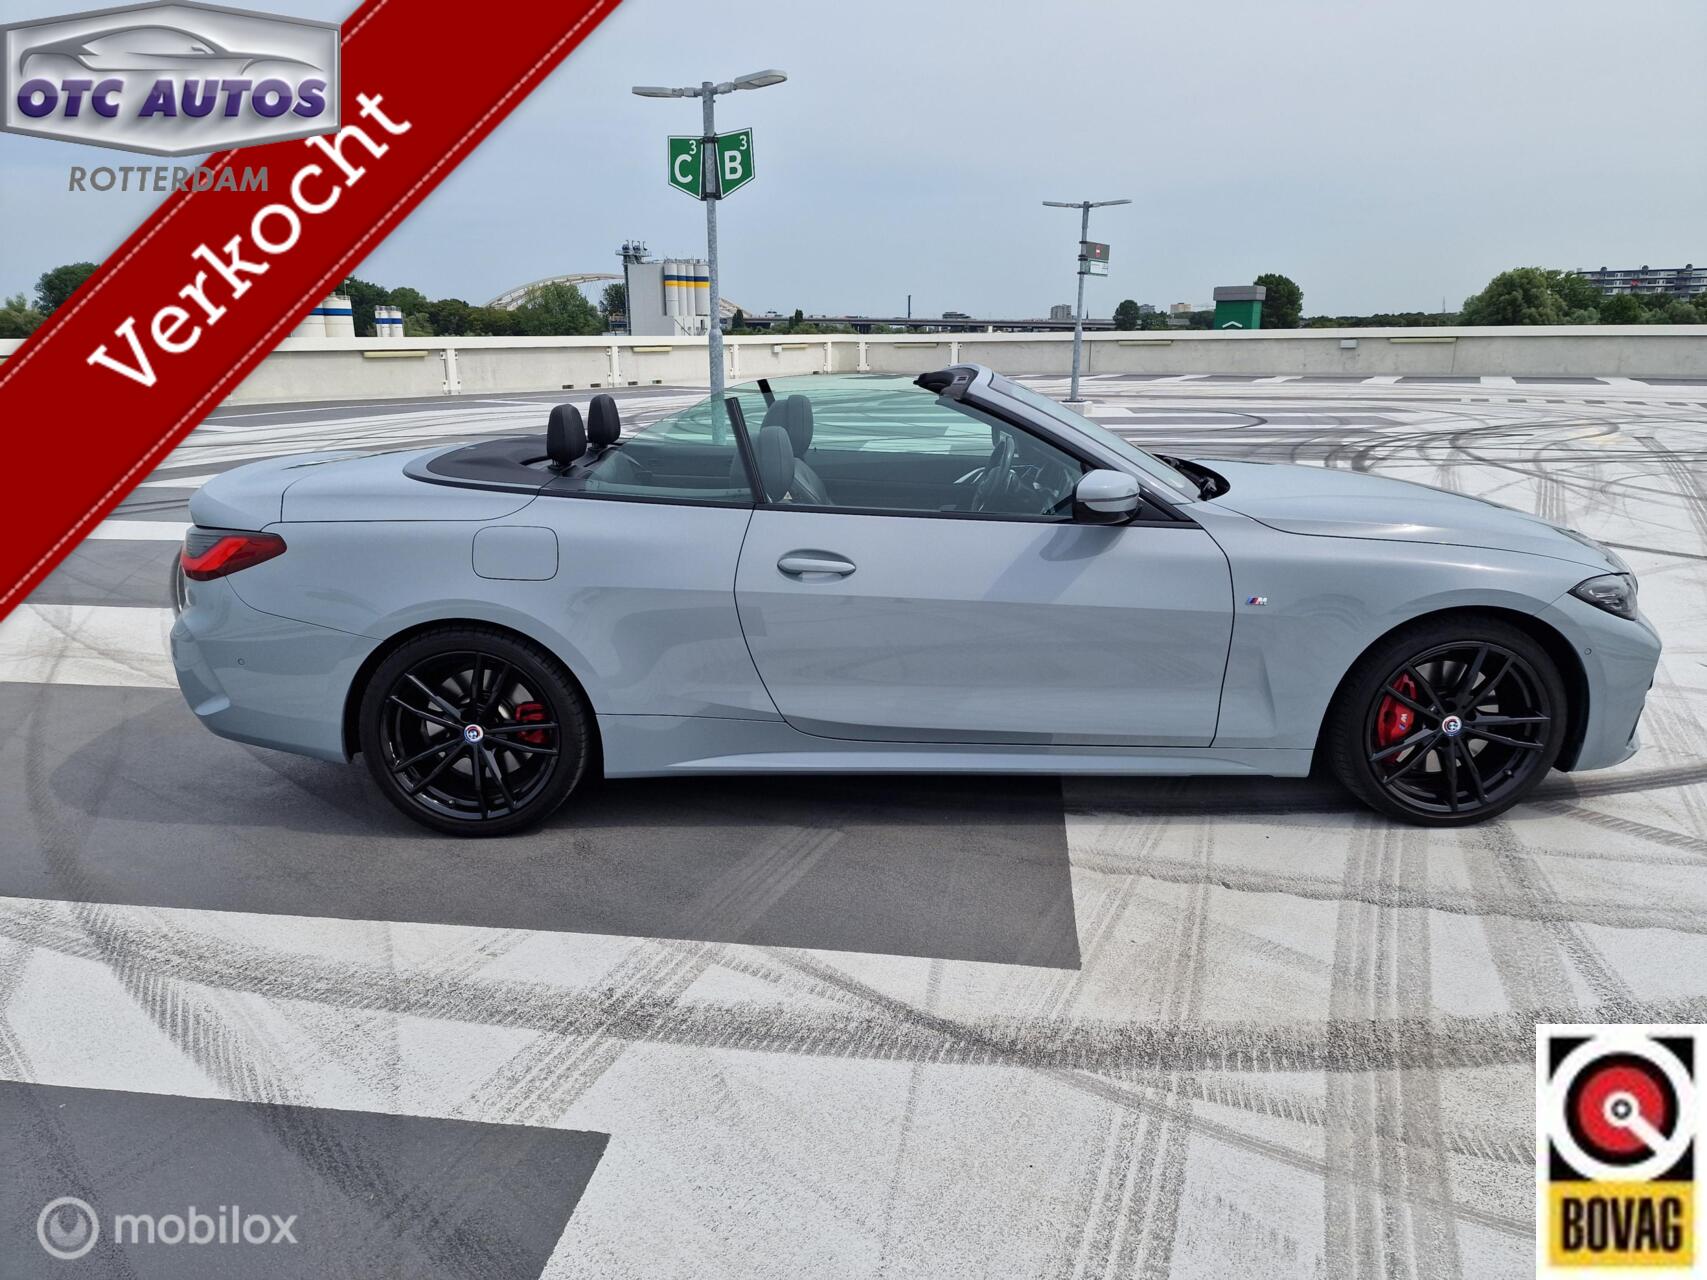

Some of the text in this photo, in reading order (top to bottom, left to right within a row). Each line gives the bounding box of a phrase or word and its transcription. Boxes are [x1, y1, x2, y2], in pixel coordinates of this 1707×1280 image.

[688, 140, 697, 155] 3
[739, 135, 748, 150] 3
[674, 153, 693, 184] C
[724, 150, 743, 180] B
